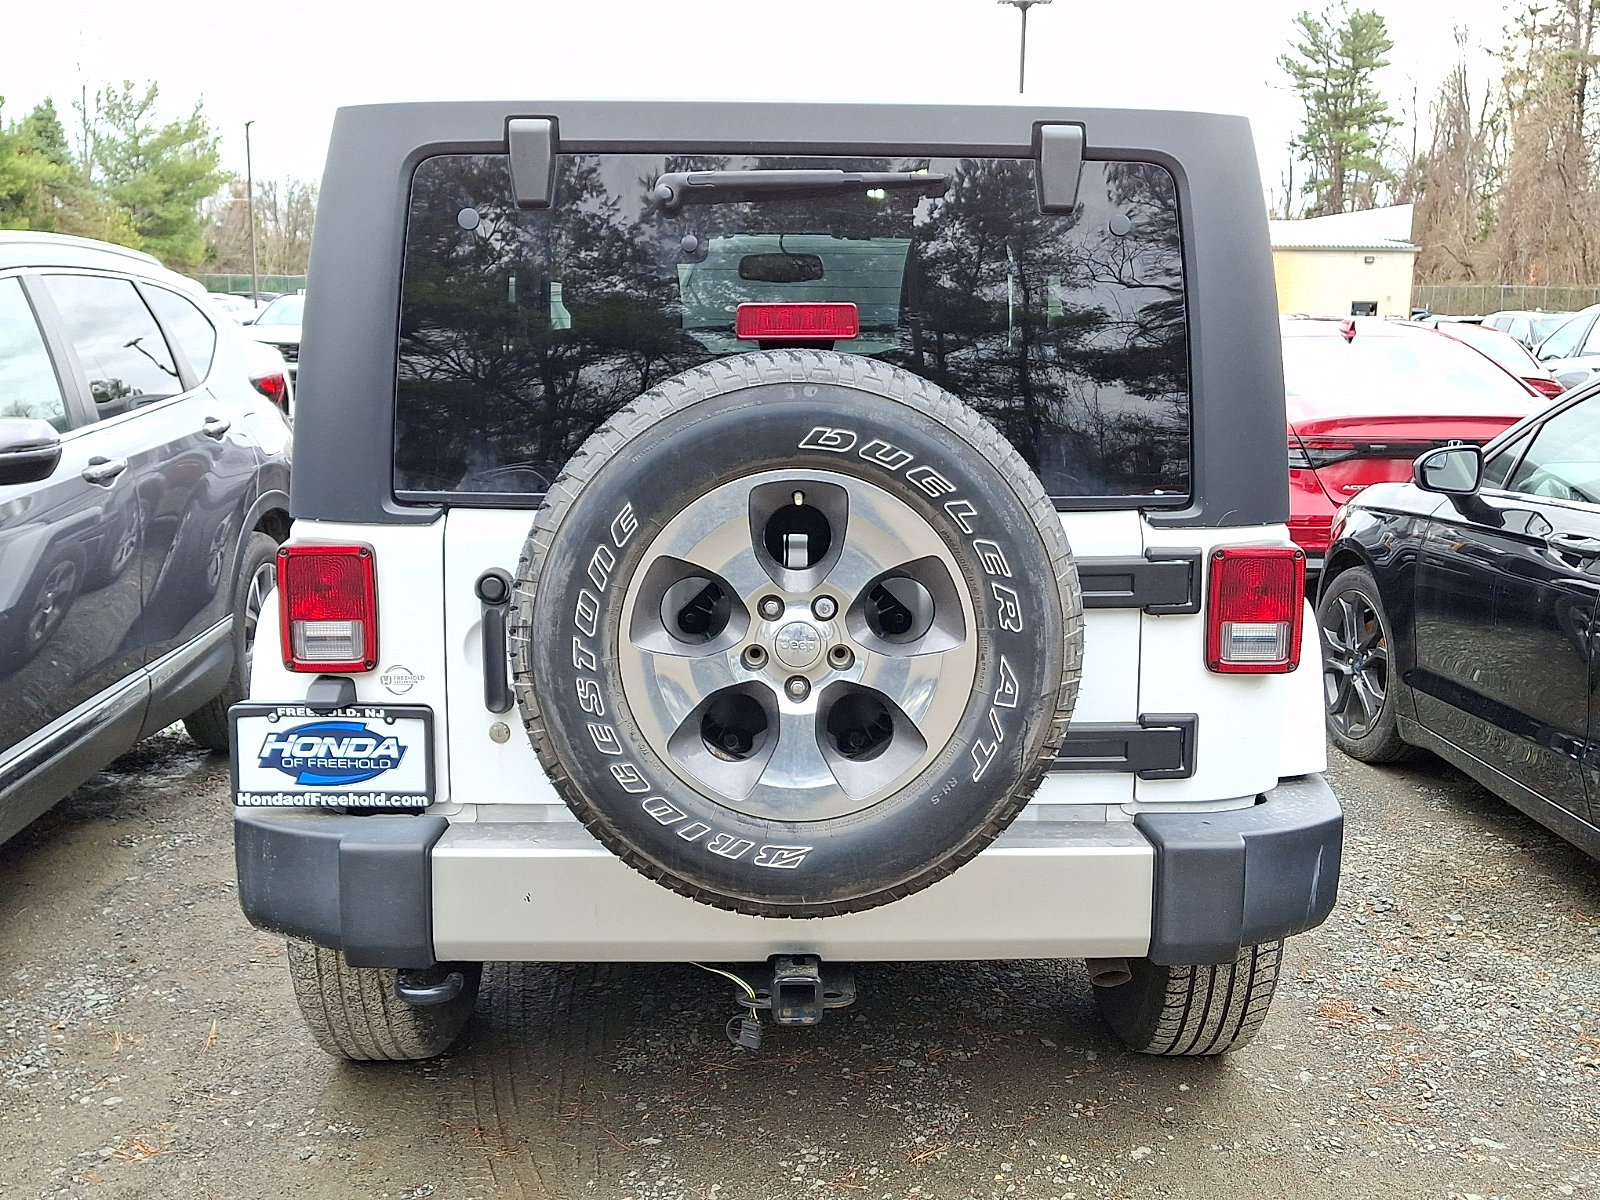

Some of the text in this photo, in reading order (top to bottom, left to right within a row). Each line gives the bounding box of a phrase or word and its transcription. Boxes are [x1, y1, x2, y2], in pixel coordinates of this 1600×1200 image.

[798, 427, 1022, 634] DUELER
[970, 654, 1020, 783] A/T
[573, 502, 814, 870] BRIDGESTONE
[276, 707, 386, 718] FREEOLD, NJ
[258, 733, 400, 759] HONDA
[281, 757, 391, 769] OF FREEHOLD
[237, 792, 429, 807] HondaofFreehold.com
